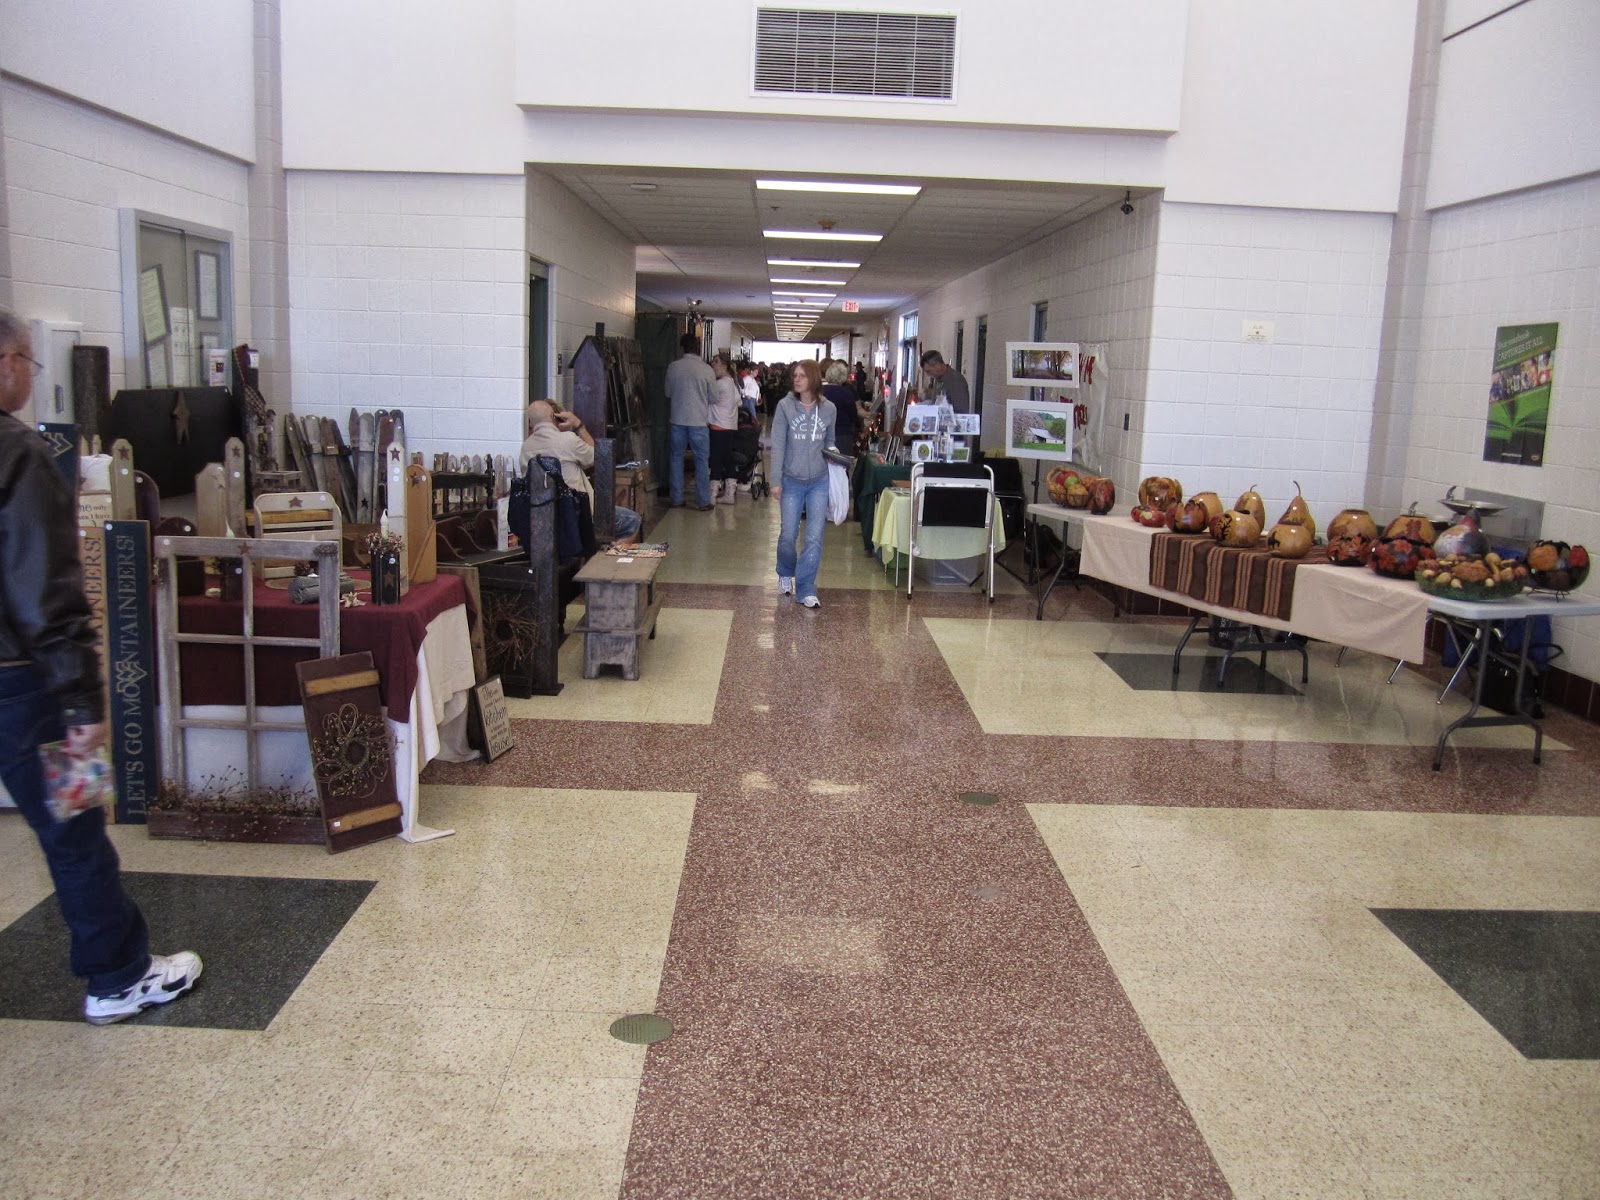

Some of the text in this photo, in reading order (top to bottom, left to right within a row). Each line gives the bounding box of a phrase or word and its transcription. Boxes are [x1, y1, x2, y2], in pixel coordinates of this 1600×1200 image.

[845, 301, 856, 311] EXIT
[124, 722, 143, 755] GO
[125, 760, 147, 815] LET'S
